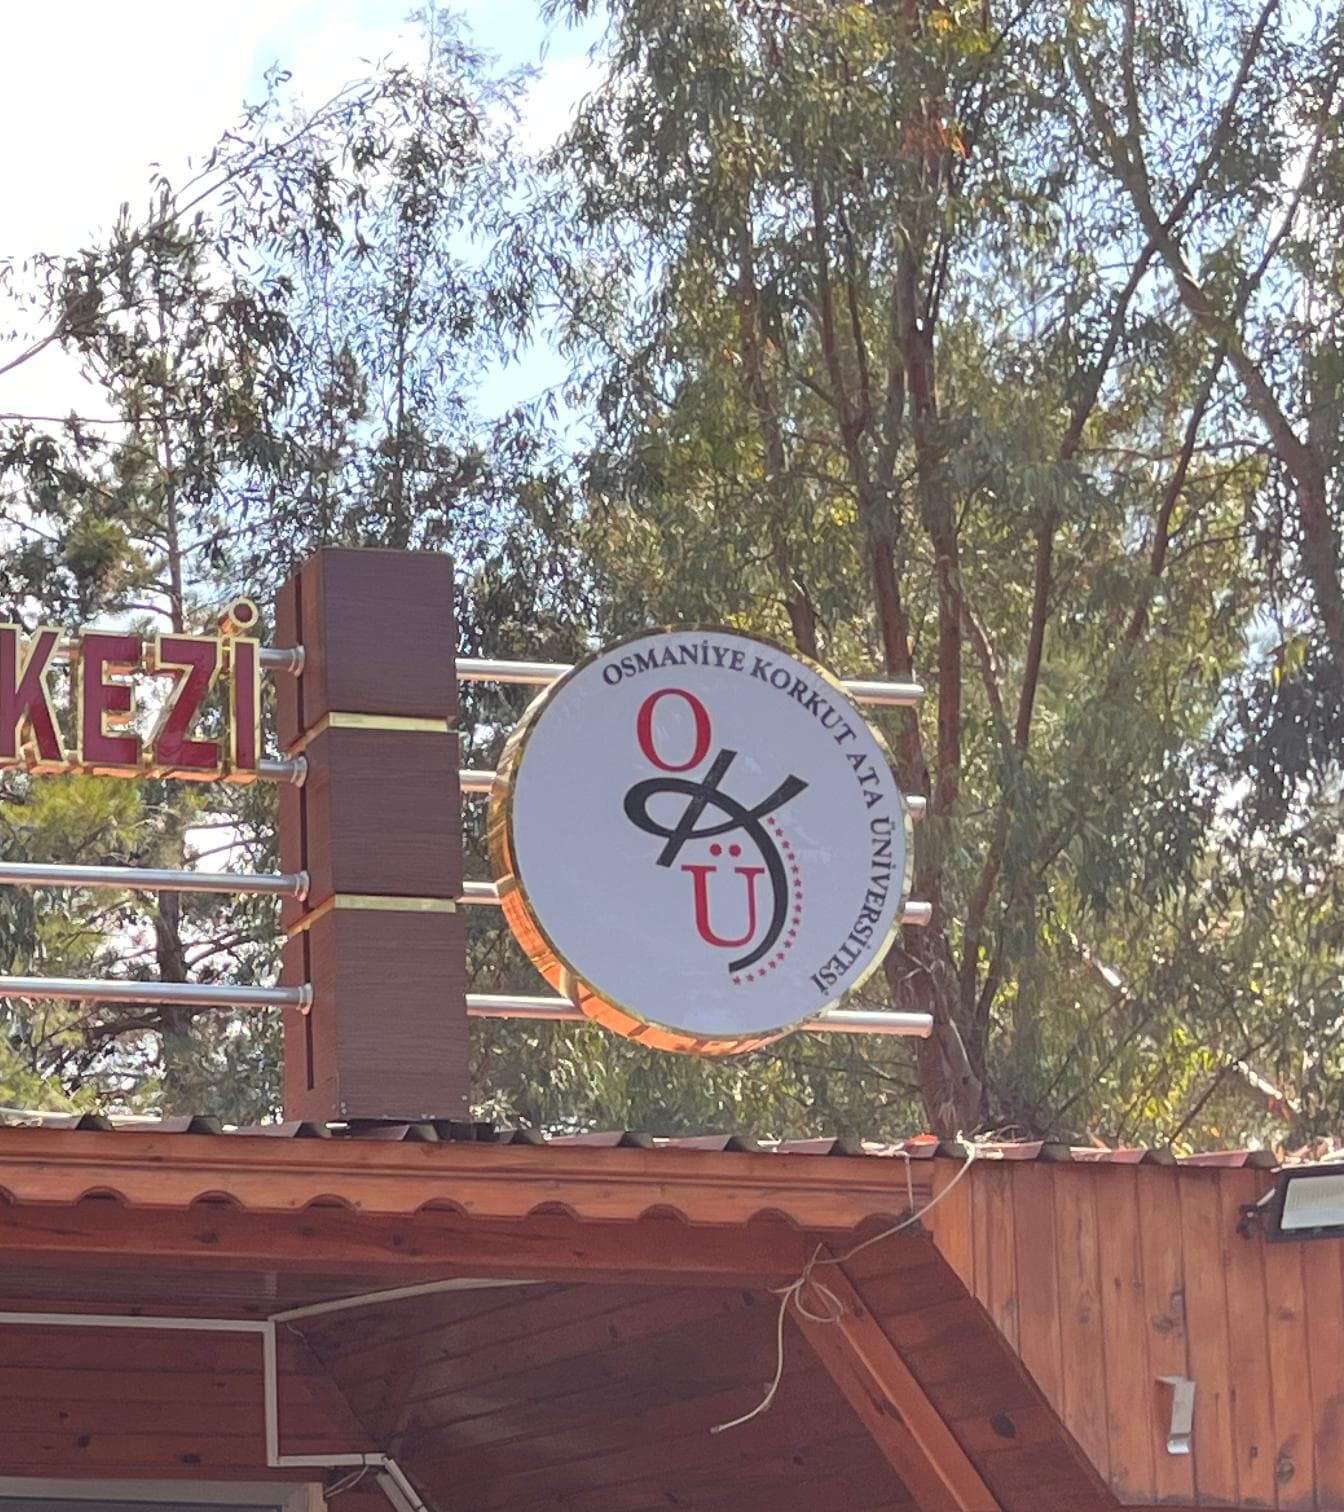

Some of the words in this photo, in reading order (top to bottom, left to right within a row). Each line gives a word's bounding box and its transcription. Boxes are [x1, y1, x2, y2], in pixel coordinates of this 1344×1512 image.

[602, 639, 745, 686] OSMANİYE
[750, 656, 856, 746] KORKUT
[846, 750, 884, 809] ATA
[809, 816, 894, 996] ÜNİVERSİTESİ
